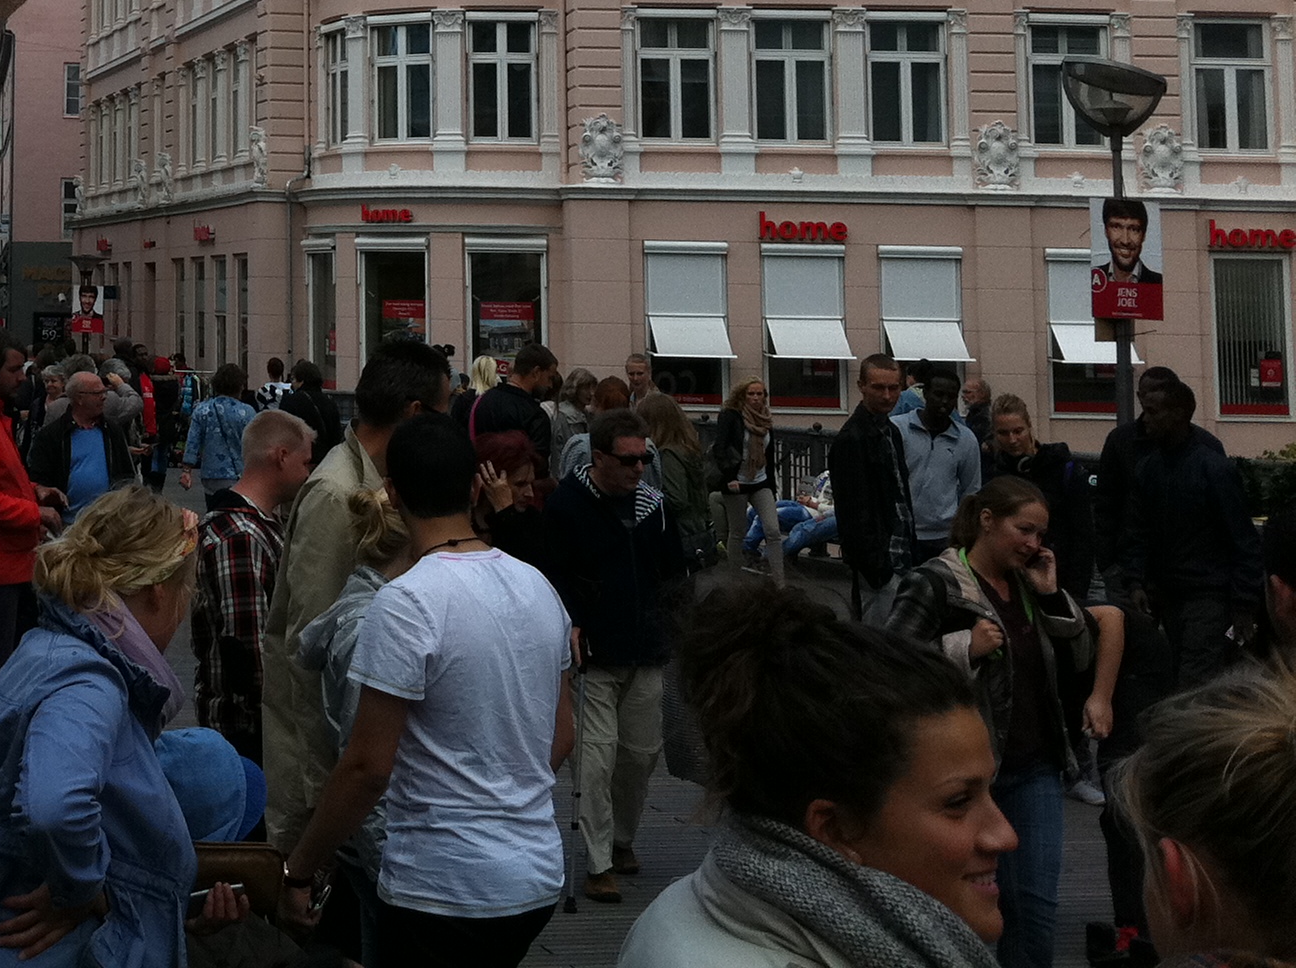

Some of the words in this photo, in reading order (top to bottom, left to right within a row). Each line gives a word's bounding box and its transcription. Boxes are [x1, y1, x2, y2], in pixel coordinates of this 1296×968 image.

[361, 203, 413, 222] home
[759, 211, 847, 241] home
[1208, 219, 1296, 248] home
[1092, 273, 1102, 285] A
[1117, 287, 1138, 298] JENS
[1117, 298, 1139, 308] JOEL
